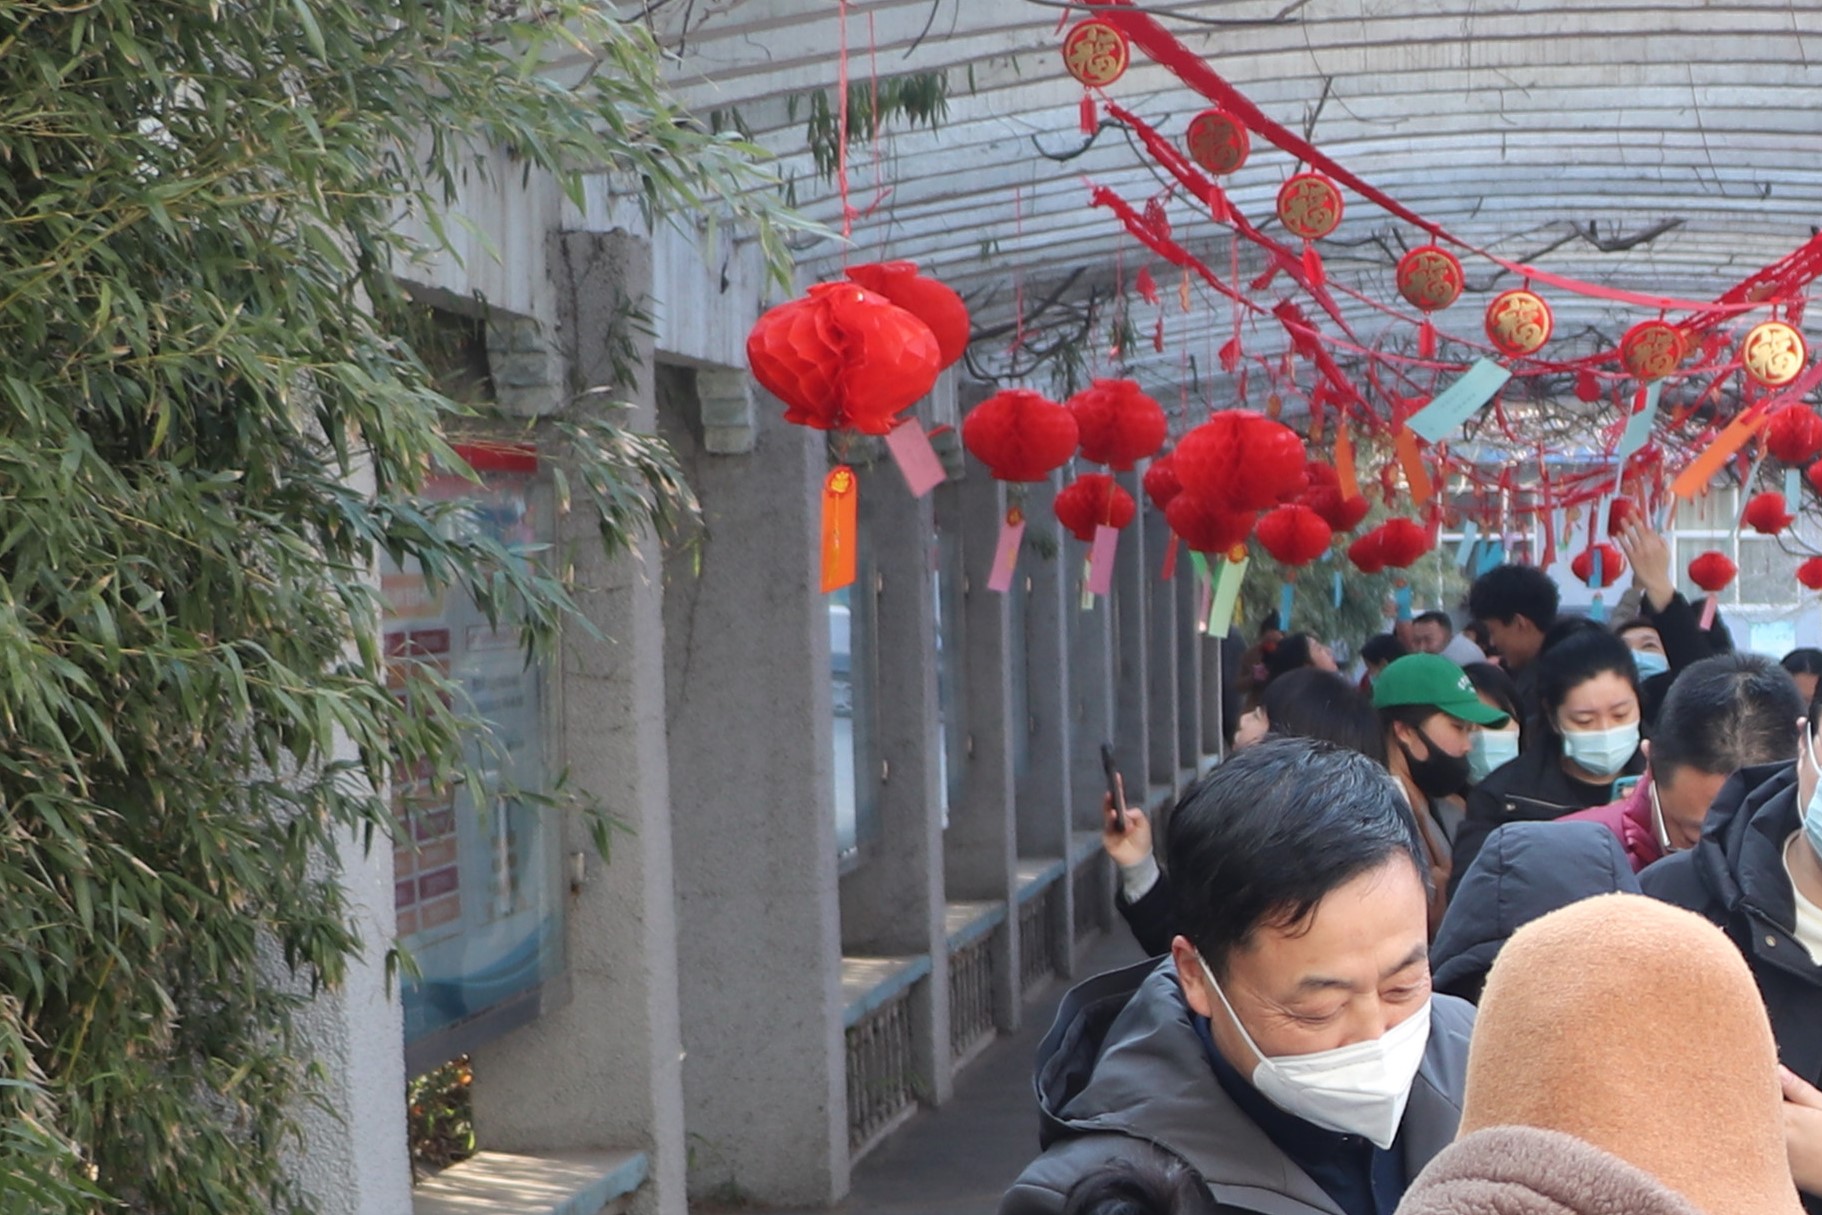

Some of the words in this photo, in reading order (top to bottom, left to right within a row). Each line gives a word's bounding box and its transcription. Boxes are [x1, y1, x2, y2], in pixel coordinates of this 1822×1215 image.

[1068, 26, 1123, 81] 福
[1280, 180, 1337, 234] 福
[1402, 254, 1457, 307] 福
[1491, 295, 1546, 351] 福
[1747, 325, 1801, 380] 福
